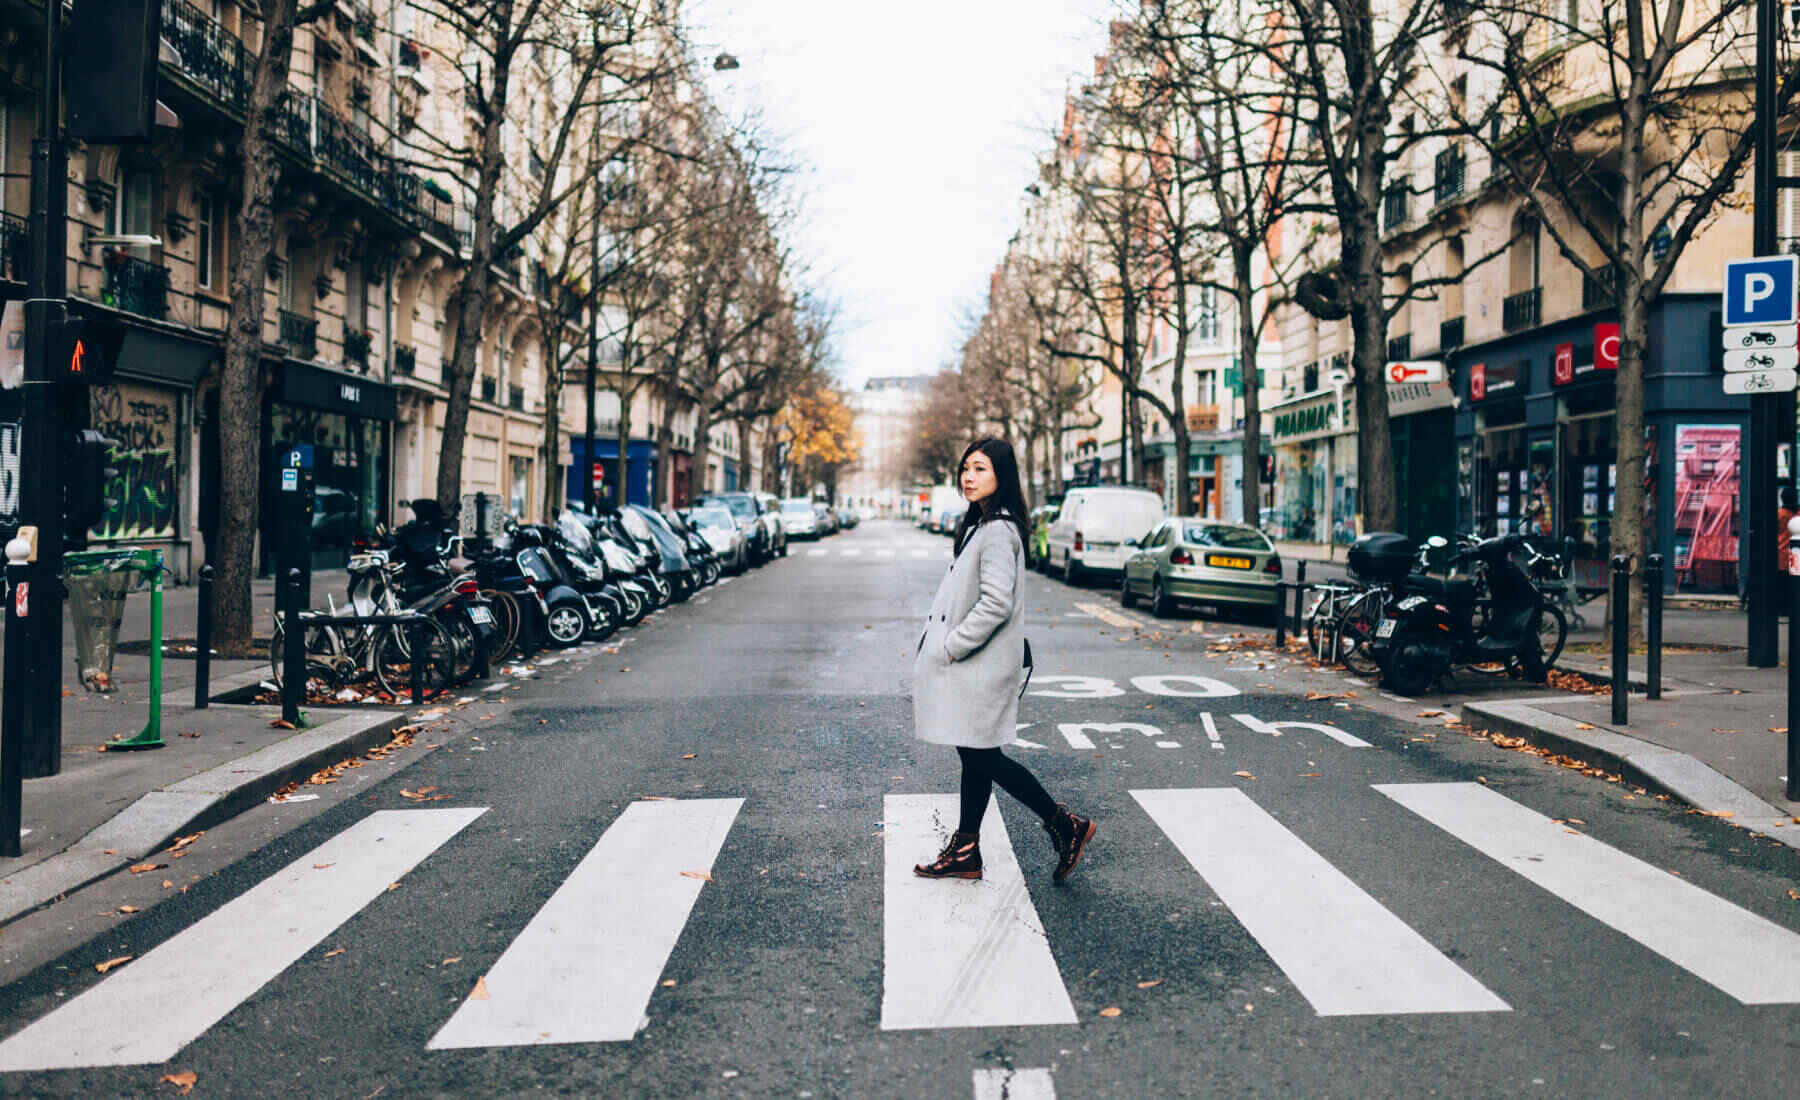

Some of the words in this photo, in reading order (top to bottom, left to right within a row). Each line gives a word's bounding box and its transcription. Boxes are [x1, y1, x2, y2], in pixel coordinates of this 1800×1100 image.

[1744, 273, 1775, 313] P
[1274, 400, 1351, 438] PHARMACE
[291, 452, 301, 467] P
[1028, 675, 1241, 698] 30
